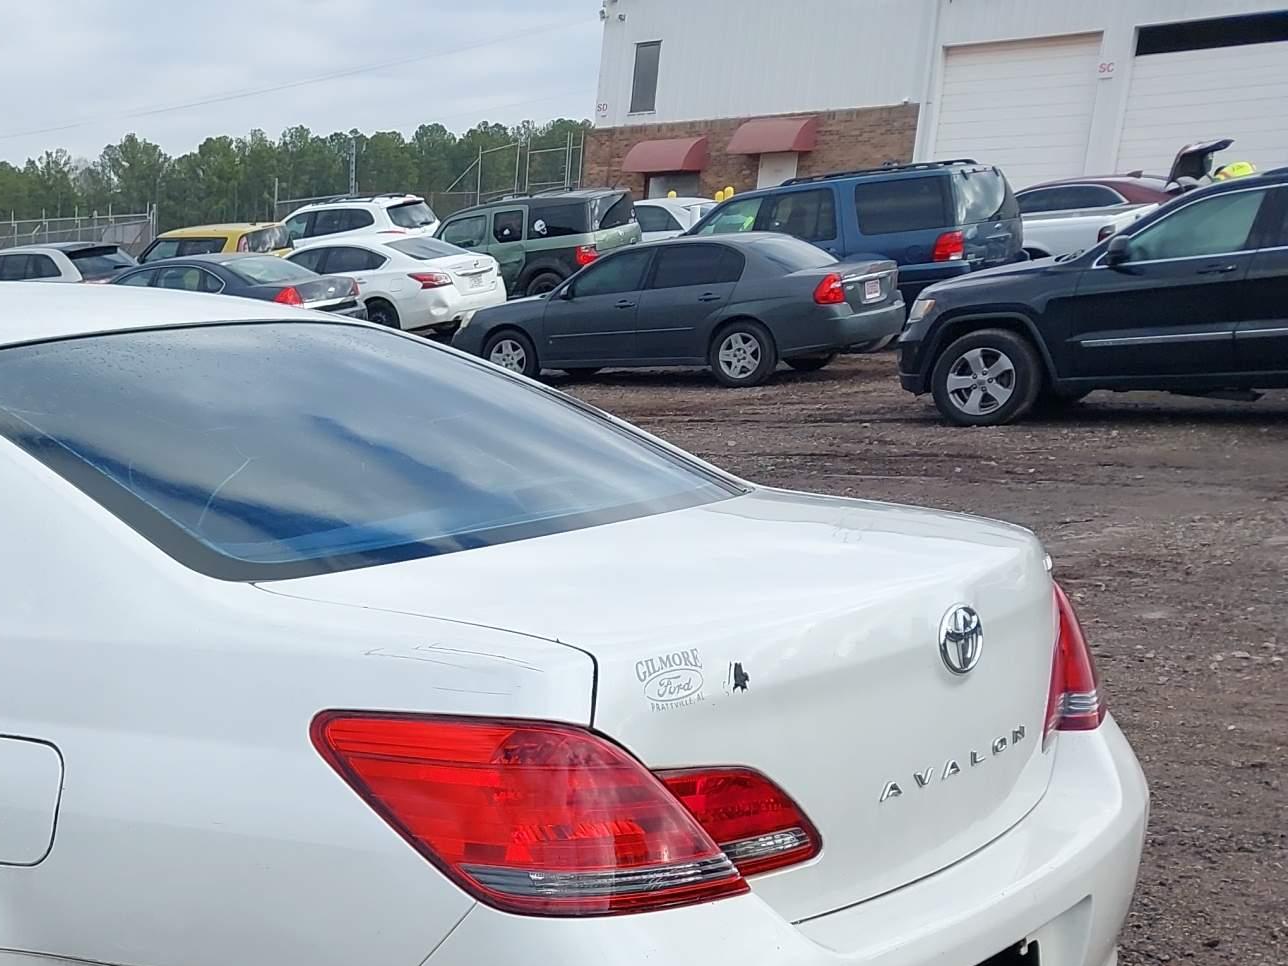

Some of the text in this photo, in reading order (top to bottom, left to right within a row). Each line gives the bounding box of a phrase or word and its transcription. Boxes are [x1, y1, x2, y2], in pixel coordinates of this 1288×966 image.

[1098, 62, 1115, 73] SC
[597, 103, 608, 112] SD
[635, 648, 703, 683] GILMORE
[657, 675, 693, 697] Ford
[879, 725, 1025, 803] AVALON
